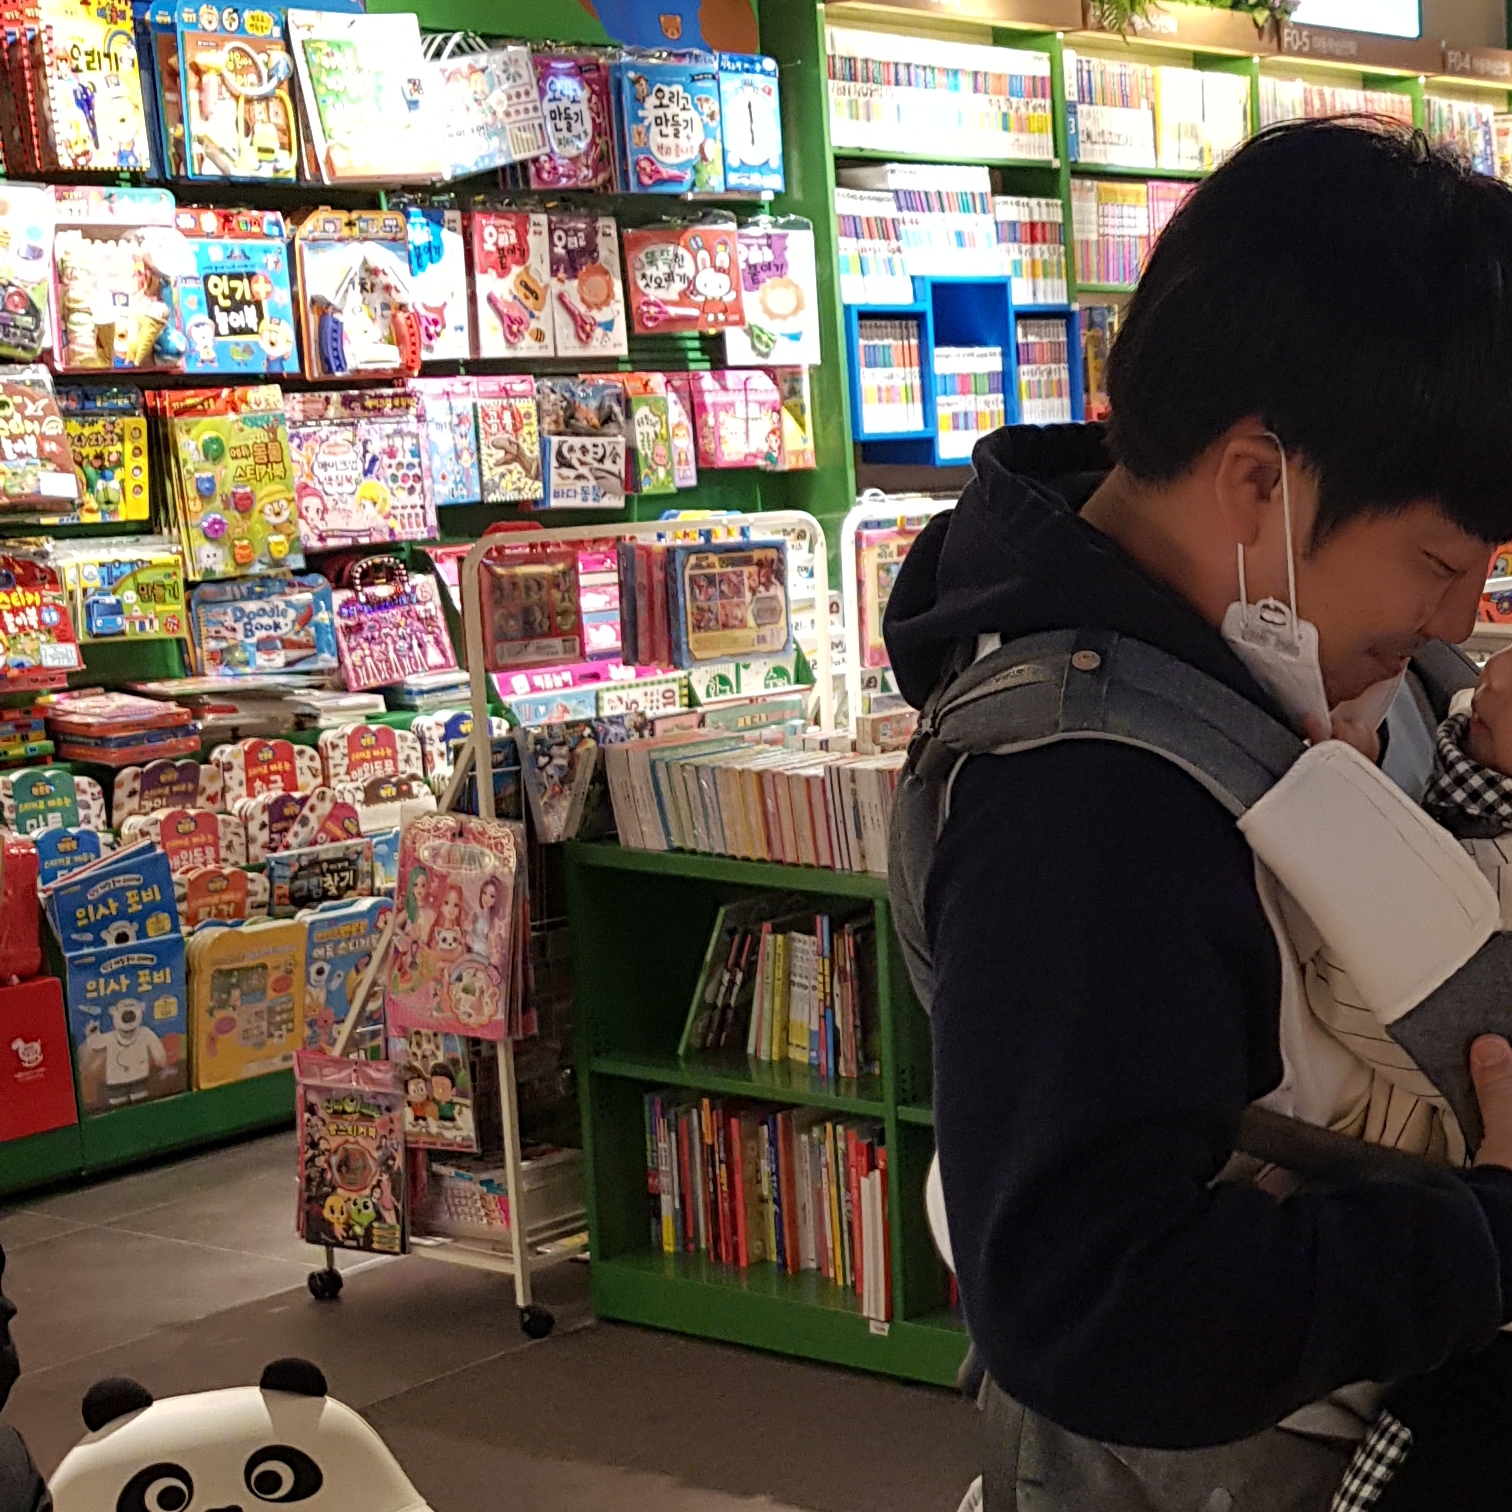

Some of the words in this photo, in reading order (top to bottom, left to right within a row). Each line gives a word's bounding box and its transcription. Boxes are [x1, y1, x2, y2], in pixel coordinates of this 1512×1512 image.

[70, 43, 119, 73] 오리기
[653, 87, 691, 111] 오리고
[549, 105, 584, 134] 만들기
[654, 112, 694, 139] 만들기
[207, 274, 251, 307] 인기
[553, 487, 577, 501] 바다
[230, 602, 288, 624] Doodle
[243, 621, 282, 638] Book
[75, 904, 118, 927] 의사
[126, 884, 162, 914] 포비
[85, 974, 131, 998] 의사
[136, 967, 172, 993] 포비
